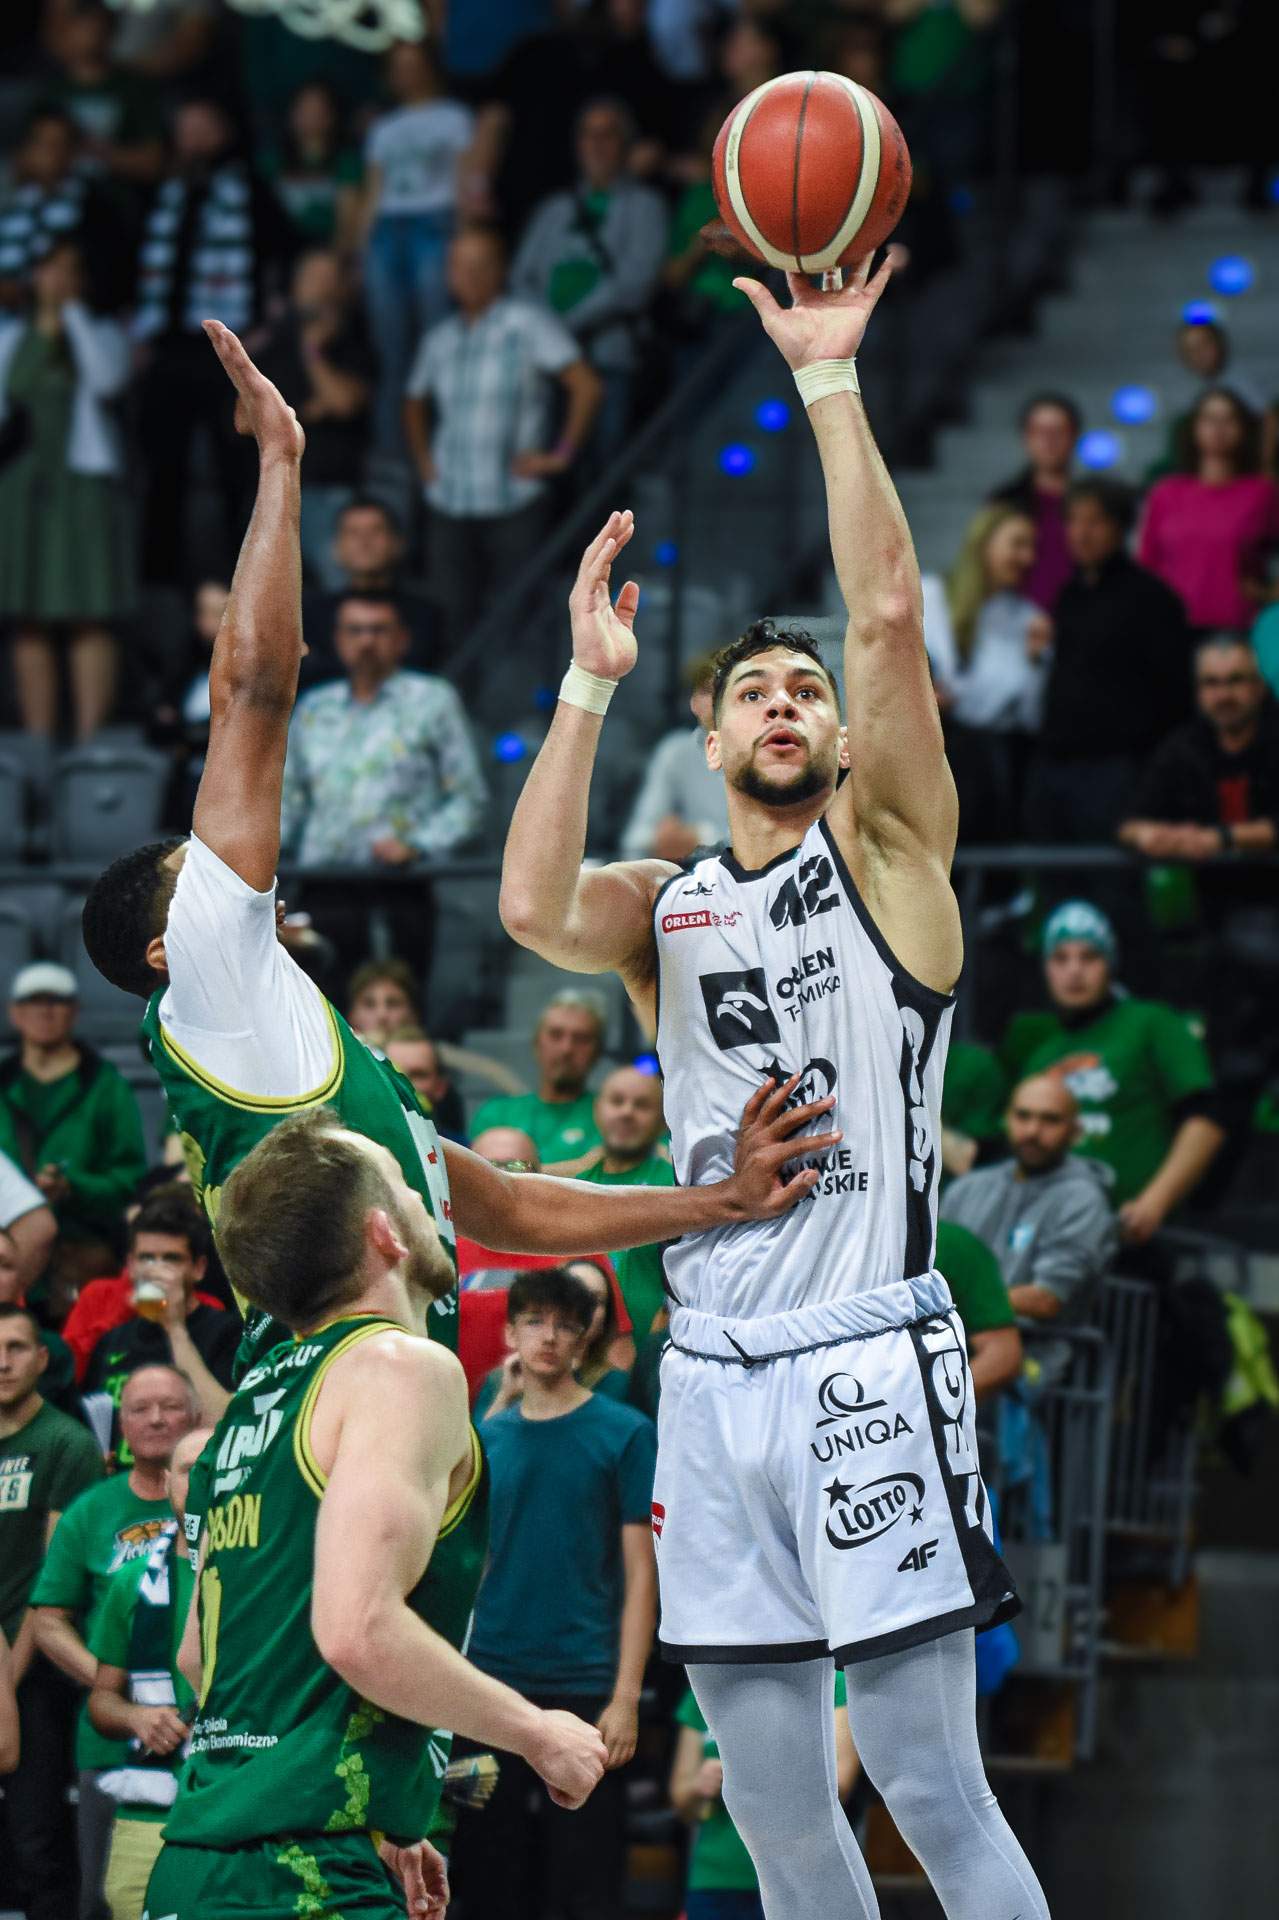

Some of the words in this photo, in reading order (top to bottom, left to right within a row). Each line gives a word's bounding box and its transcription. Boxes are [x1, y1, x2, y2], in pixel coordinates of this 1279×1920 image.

[665, 913, 707, 929] ORLEN
[811, 1413, 914, 1462] UNIQA
[838, 1485, 906, 1535] LOTTO
[897, 1538, 939, 1572] 4F
